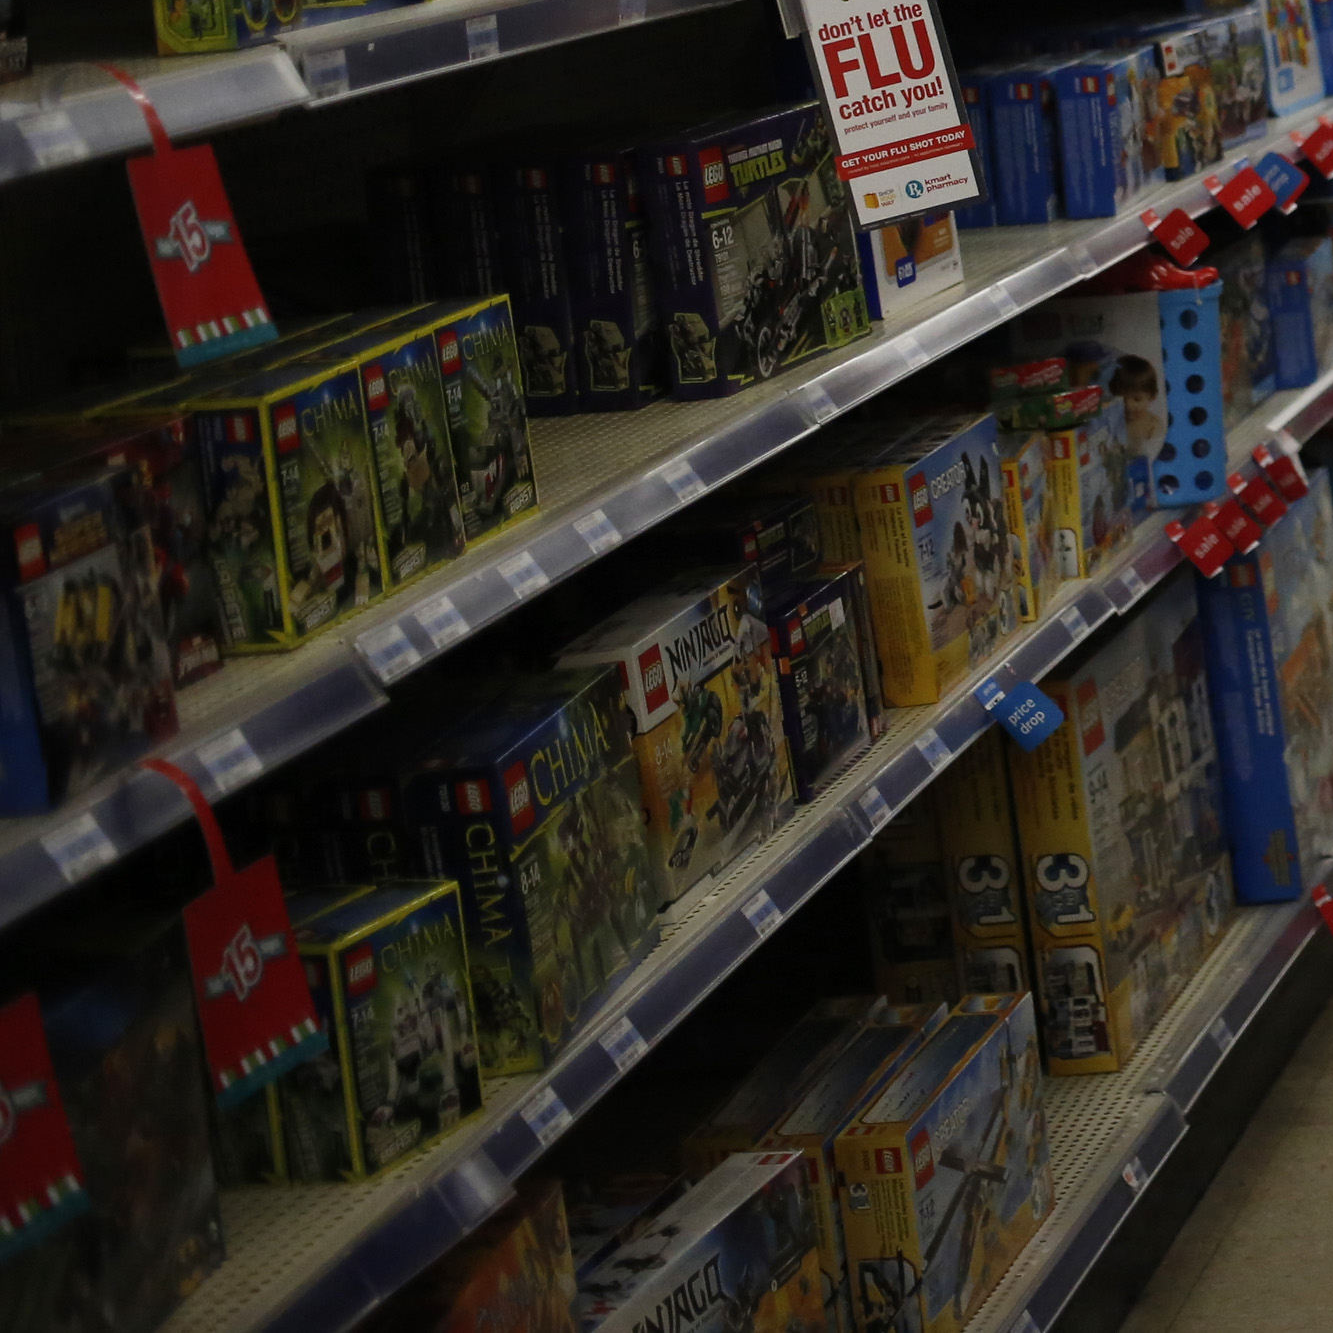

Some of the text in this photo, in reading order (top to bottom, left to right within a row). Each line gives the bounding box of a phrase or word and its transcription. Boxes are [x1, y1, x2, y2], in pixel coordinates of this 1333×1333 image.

[819, 4, 923, 42] don't let the
[822, 19, 936, 99] FLU
[839, 76, 945, 120] catch you!
[844, 102, 949, 135] protect yourself and your family
[841, 157, 861, 169] GET
[862, 151, 889, 163] YOUR
[890, 146, 908, 156] FLU
[910, 139, 934, 151] SHOT
[936, 130, 966, 143] TODAY
[703, 162, 725, 186] LEGO
[729, 149, 787, 188] TURTLES
[925, 174, 952, 185] kmart
[926, 176, 968, 193] pharmacy
[1232, 184, 1262, 213] sale
[170, 200, 209, 272] 15
[686, 211, 697, 237] Dragon
[694, 249, 704, 282] Shredder
[711, 225, 734, 250] 6-12
[1171, 226, 1194, 249] sale
[441, 340, 459, 365] LEGO
[462, 320, 512, 362] CHIMA
[368, 376, 387, 400] LEGO
[389, 353, 437, 397] CHIMA
[446, 384, 463, 403] 7-14
[277, 414, 297, 440] LEGO
[301, 388, 360, 439] CHIMA
[930, 462, 967, 501] CREATOR
[912, 483, 930, 514] LEGO
[1226, 516, 1247, 539] sale
[1194, 532, 1220, 559] sale
[665, 604, 735, 693] NINJAGO
[790, 628, 803, 647] LEGO
[643, 664, 663, 695] LEGO
[1007, 698, 1036, 725] price
[1020, 710, 1046, 735] drop
[531, 703, 611, 806] CHIMA
[654, 740, 673, 765] 8-14
[464, 782, 482, 813] LEGO
[509, 780, 529, 818] LEGO
[465, 822, 513, 947] CHIMA
[520, 863, 541, 896] 8-14
[958, 854, 1010, 893] 3
[1035, 852, 1095, 925] 3 1
[381, 912, 456, 972] CHIMA
[349, 959, 374, 982] LEGO
[882, 1150, 896, 1172] LEGO
[915, 1144, 933, 1179] LEGO
